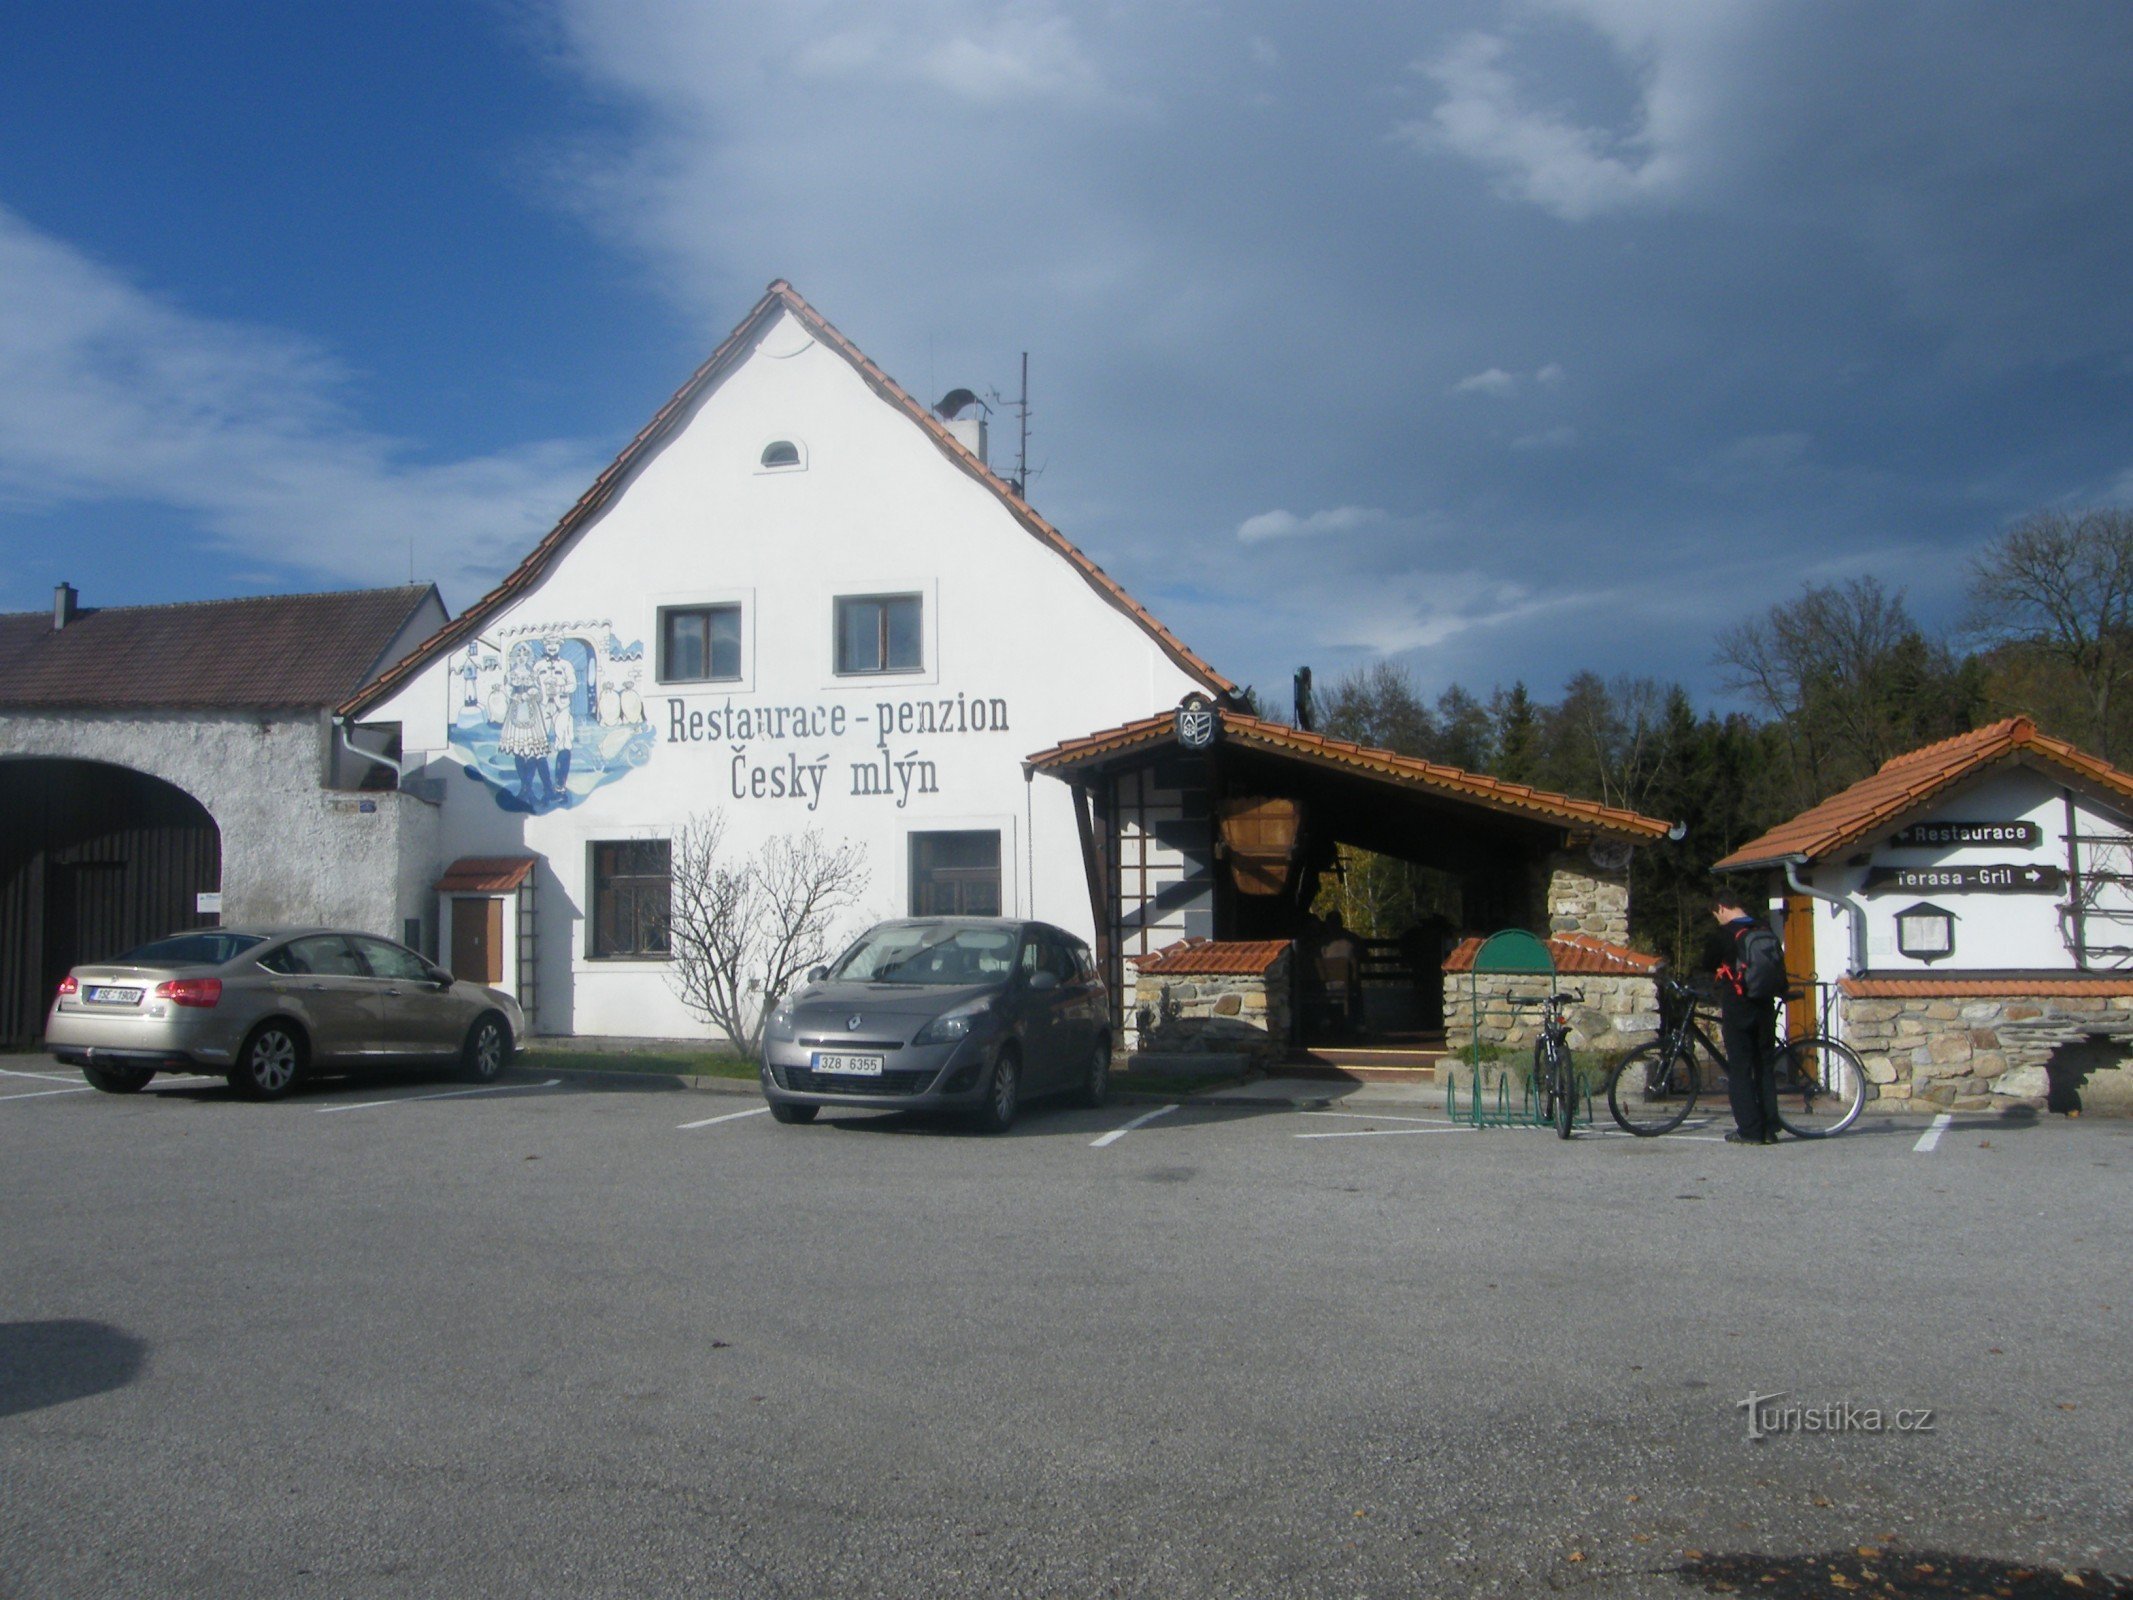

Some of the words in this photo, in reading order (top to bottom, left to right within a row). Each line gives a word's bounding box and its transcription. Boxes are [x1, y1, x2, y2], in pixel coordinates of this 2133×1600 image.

[731, 745, 830, 810] Český
[850, 748, 940, 808] mlýn
[1915, 825, 2027, 842] Restaurace
[821, 1056, 842, 1070] 3Z8
[849, 1057, 877, 1071] 6355
